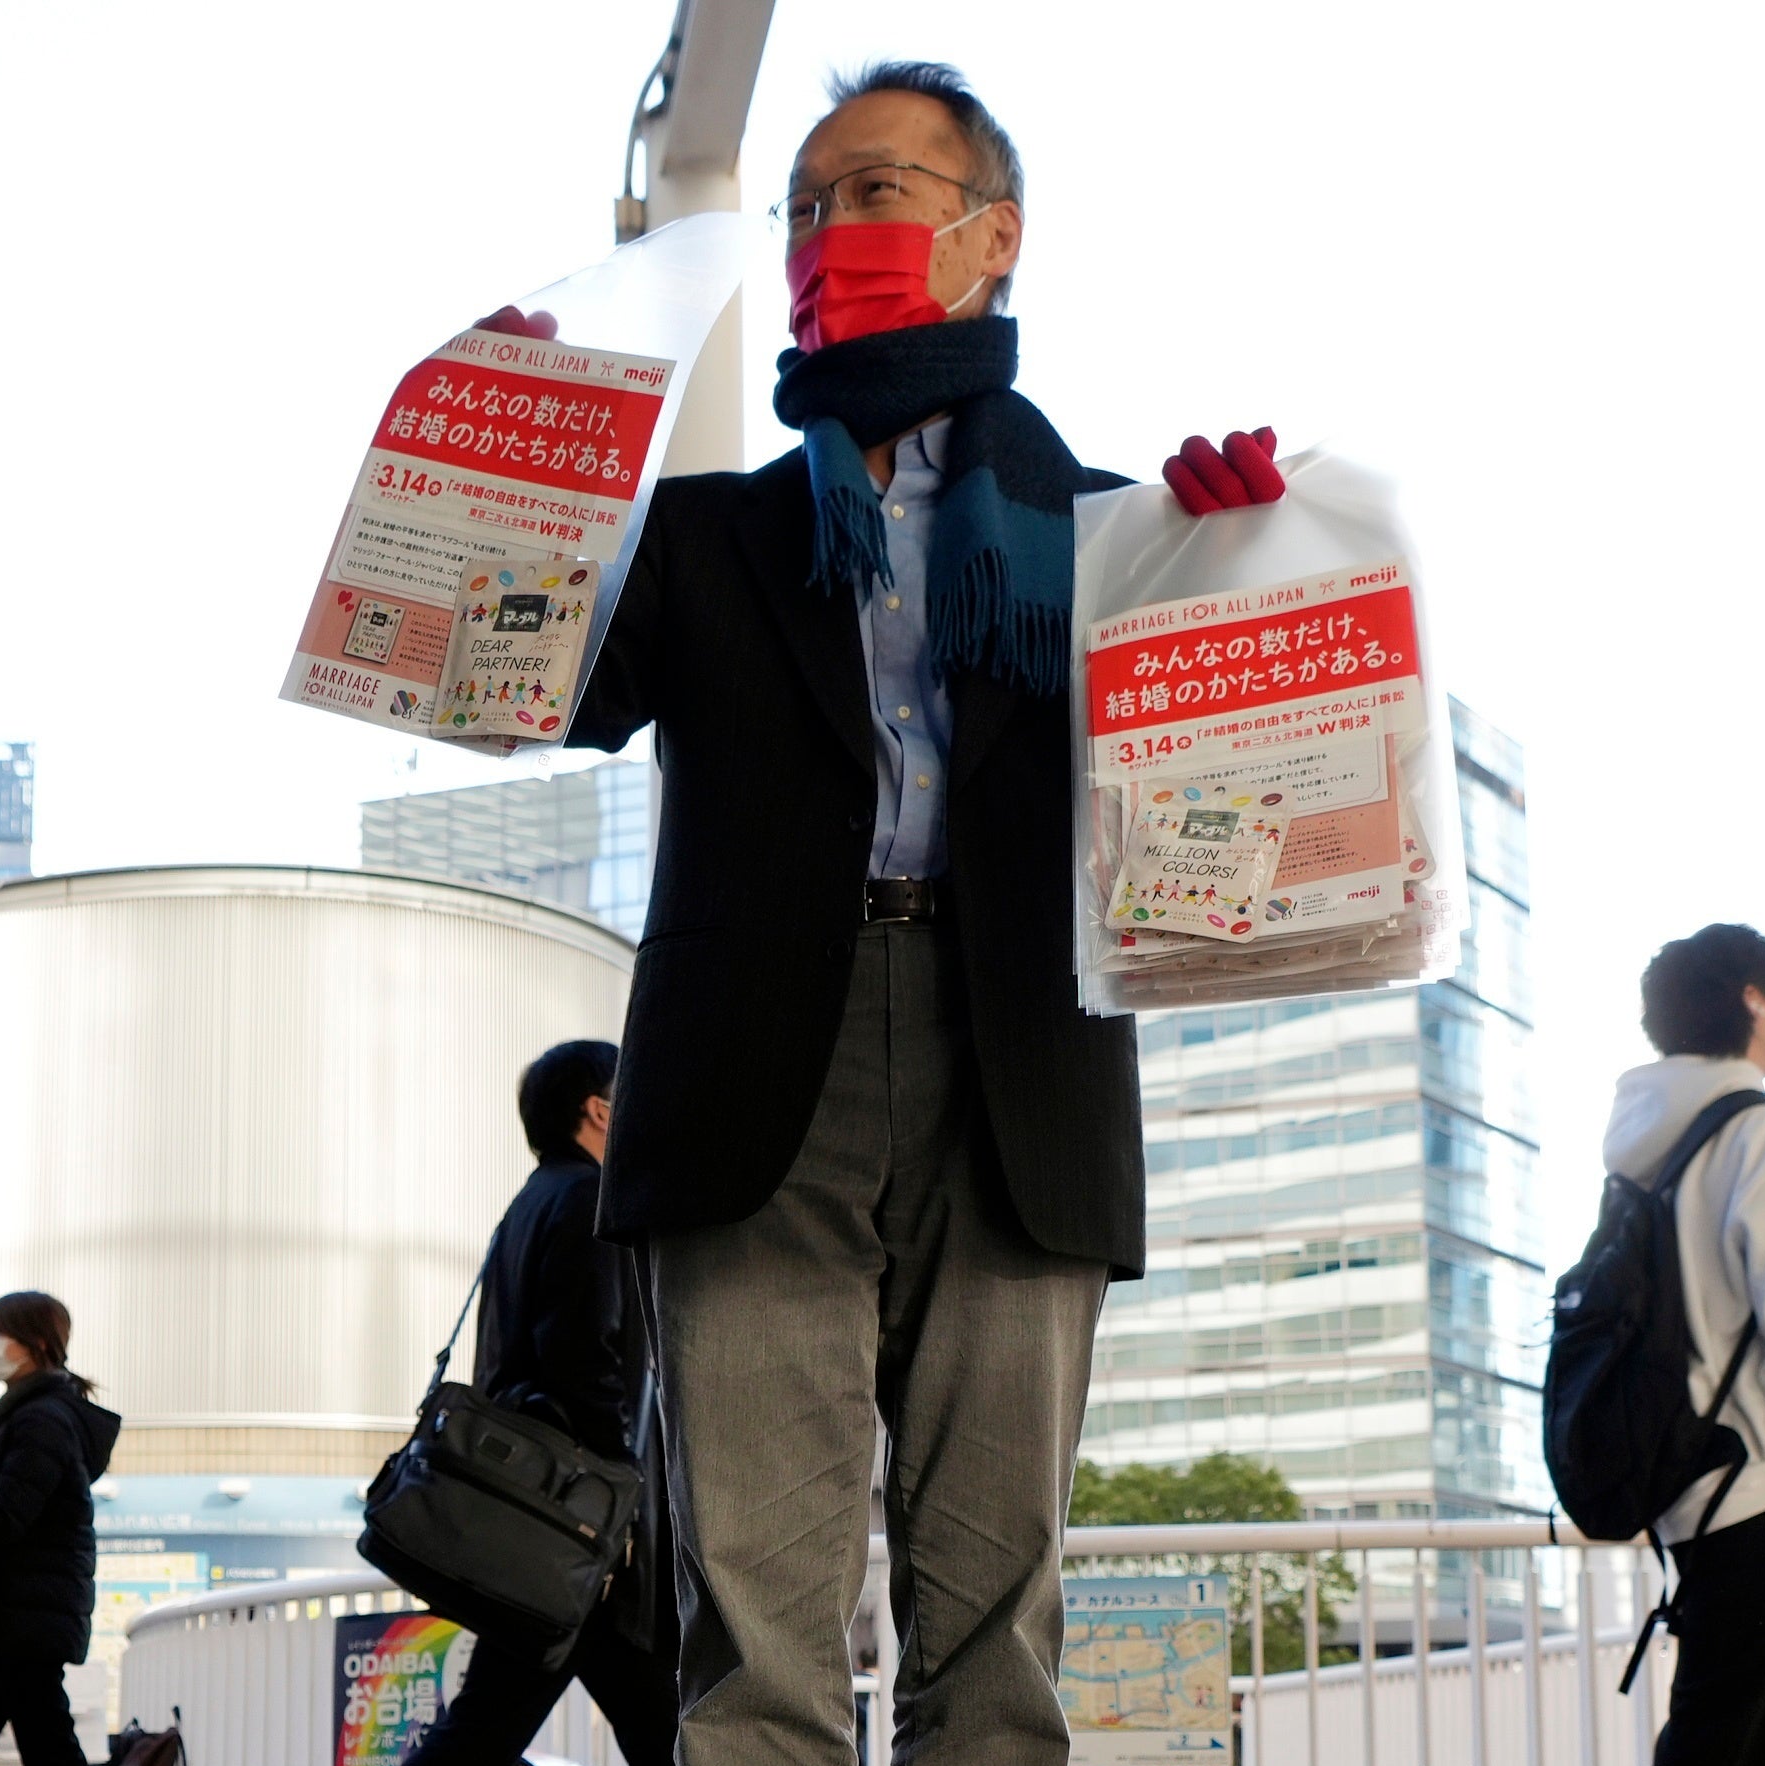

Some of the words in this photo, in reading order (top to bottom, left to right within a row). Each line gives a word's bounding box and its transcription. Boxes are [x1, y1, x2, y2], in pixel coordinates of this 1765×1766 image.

[442, 337, 486, 357] RIAGE
[489, 343, 521, 363] FOR
[525, 350, 546, 368] ALL
[550, 353, 590, 374] JAPAN
[623, 366, 667, 387] meiji
[427, 374, 616, 438] みんなの数だけ、
[388, 404, 632, 483] 結婚のかたちがある。
[376, 464, 427, 496] 3.14
[539, 519, 584, 543] W判決
[346, 558, 462, 592] ひとりでも多くの方に見守っていただけると
[351, 544, 463, 579] マリッジ・フォー・オール・ジャパンは、この
[502, 609, 539, 624] マーブル
[1099, 610, 1175, 643] MARRIAGE
[1183, 602, 1219, 622] FOR
[1227, 597, 1252, 614] ALL
[1258, 586, 1305, 610] JAPAN
[1349, 565, 1398, 588] meiji
[470, 639, 514, 654] DEAR
[1133, 612, 1368, 678] みんなの数だけ、
[308, 662, 382, 696] MARRIAGE
[471, 656, 552, 673] PARTNER!
[1105, 640, 1404, 721] 結婚のかたちがある。
[303, 681, 326, 698] FOR
[326, 686, 345, 703] ALL
[343, 689, 375, 710] JAPAN
[1317, 714, 1372, 736] W判決
[1118, 735, 1174, 764] 3.14
[1288, 772, 1360, 791] 判を応援しています。
[1143, 845, 1220, 861] MILLION
[1161, 861, 1239, 880] COLORS!
[1346, 885, 1381, 901] meiji
[1196, 1583, 1207, 1602] 1
[343, 1651, 438, 1679] ODAIBA
[343, 1679, 438, 1726] お台場
[343, 1729, 430, 1750] レインボーバ
